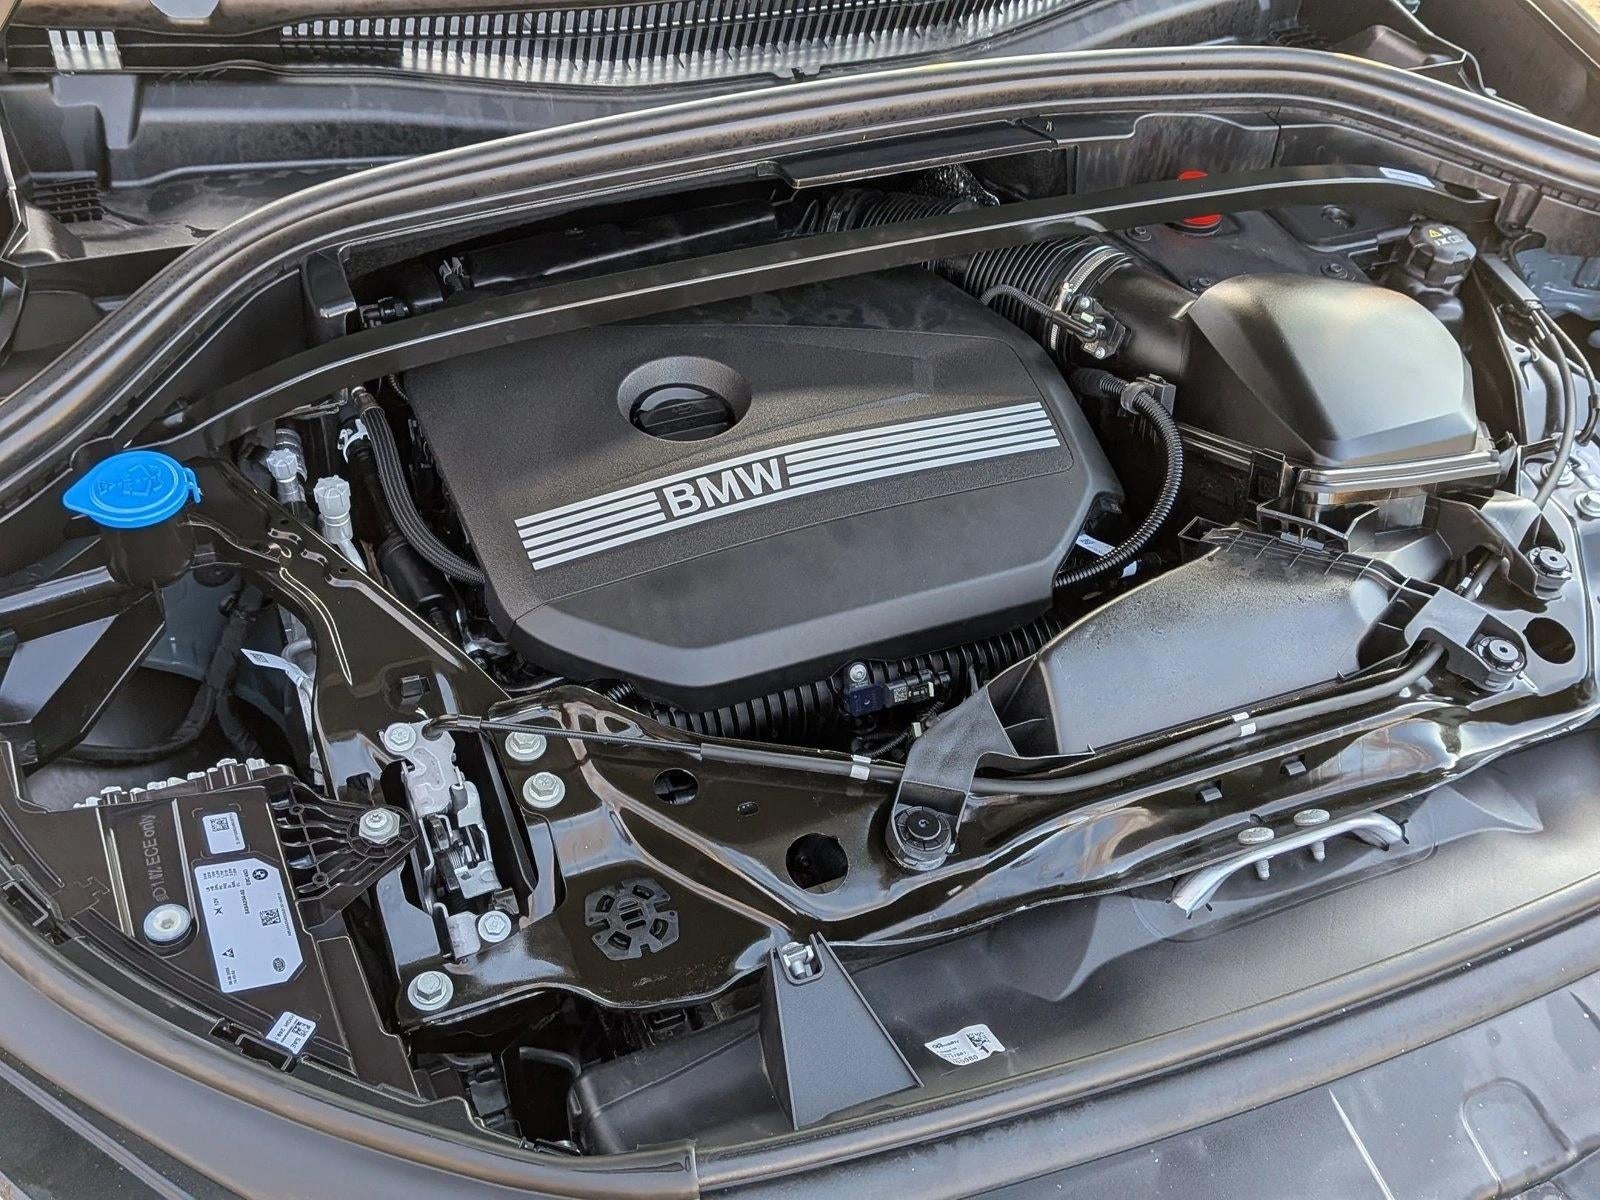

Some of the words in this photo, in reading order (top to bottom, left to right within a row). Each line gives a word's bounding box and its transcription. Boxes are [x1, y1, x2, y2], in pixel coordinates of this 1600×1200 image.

[663, 458, 783, 518] BMW
[139, 815, 156, 838] only
[142, 838, 161, 866] ECE
[290, 1036, 301, 1049] SAE
